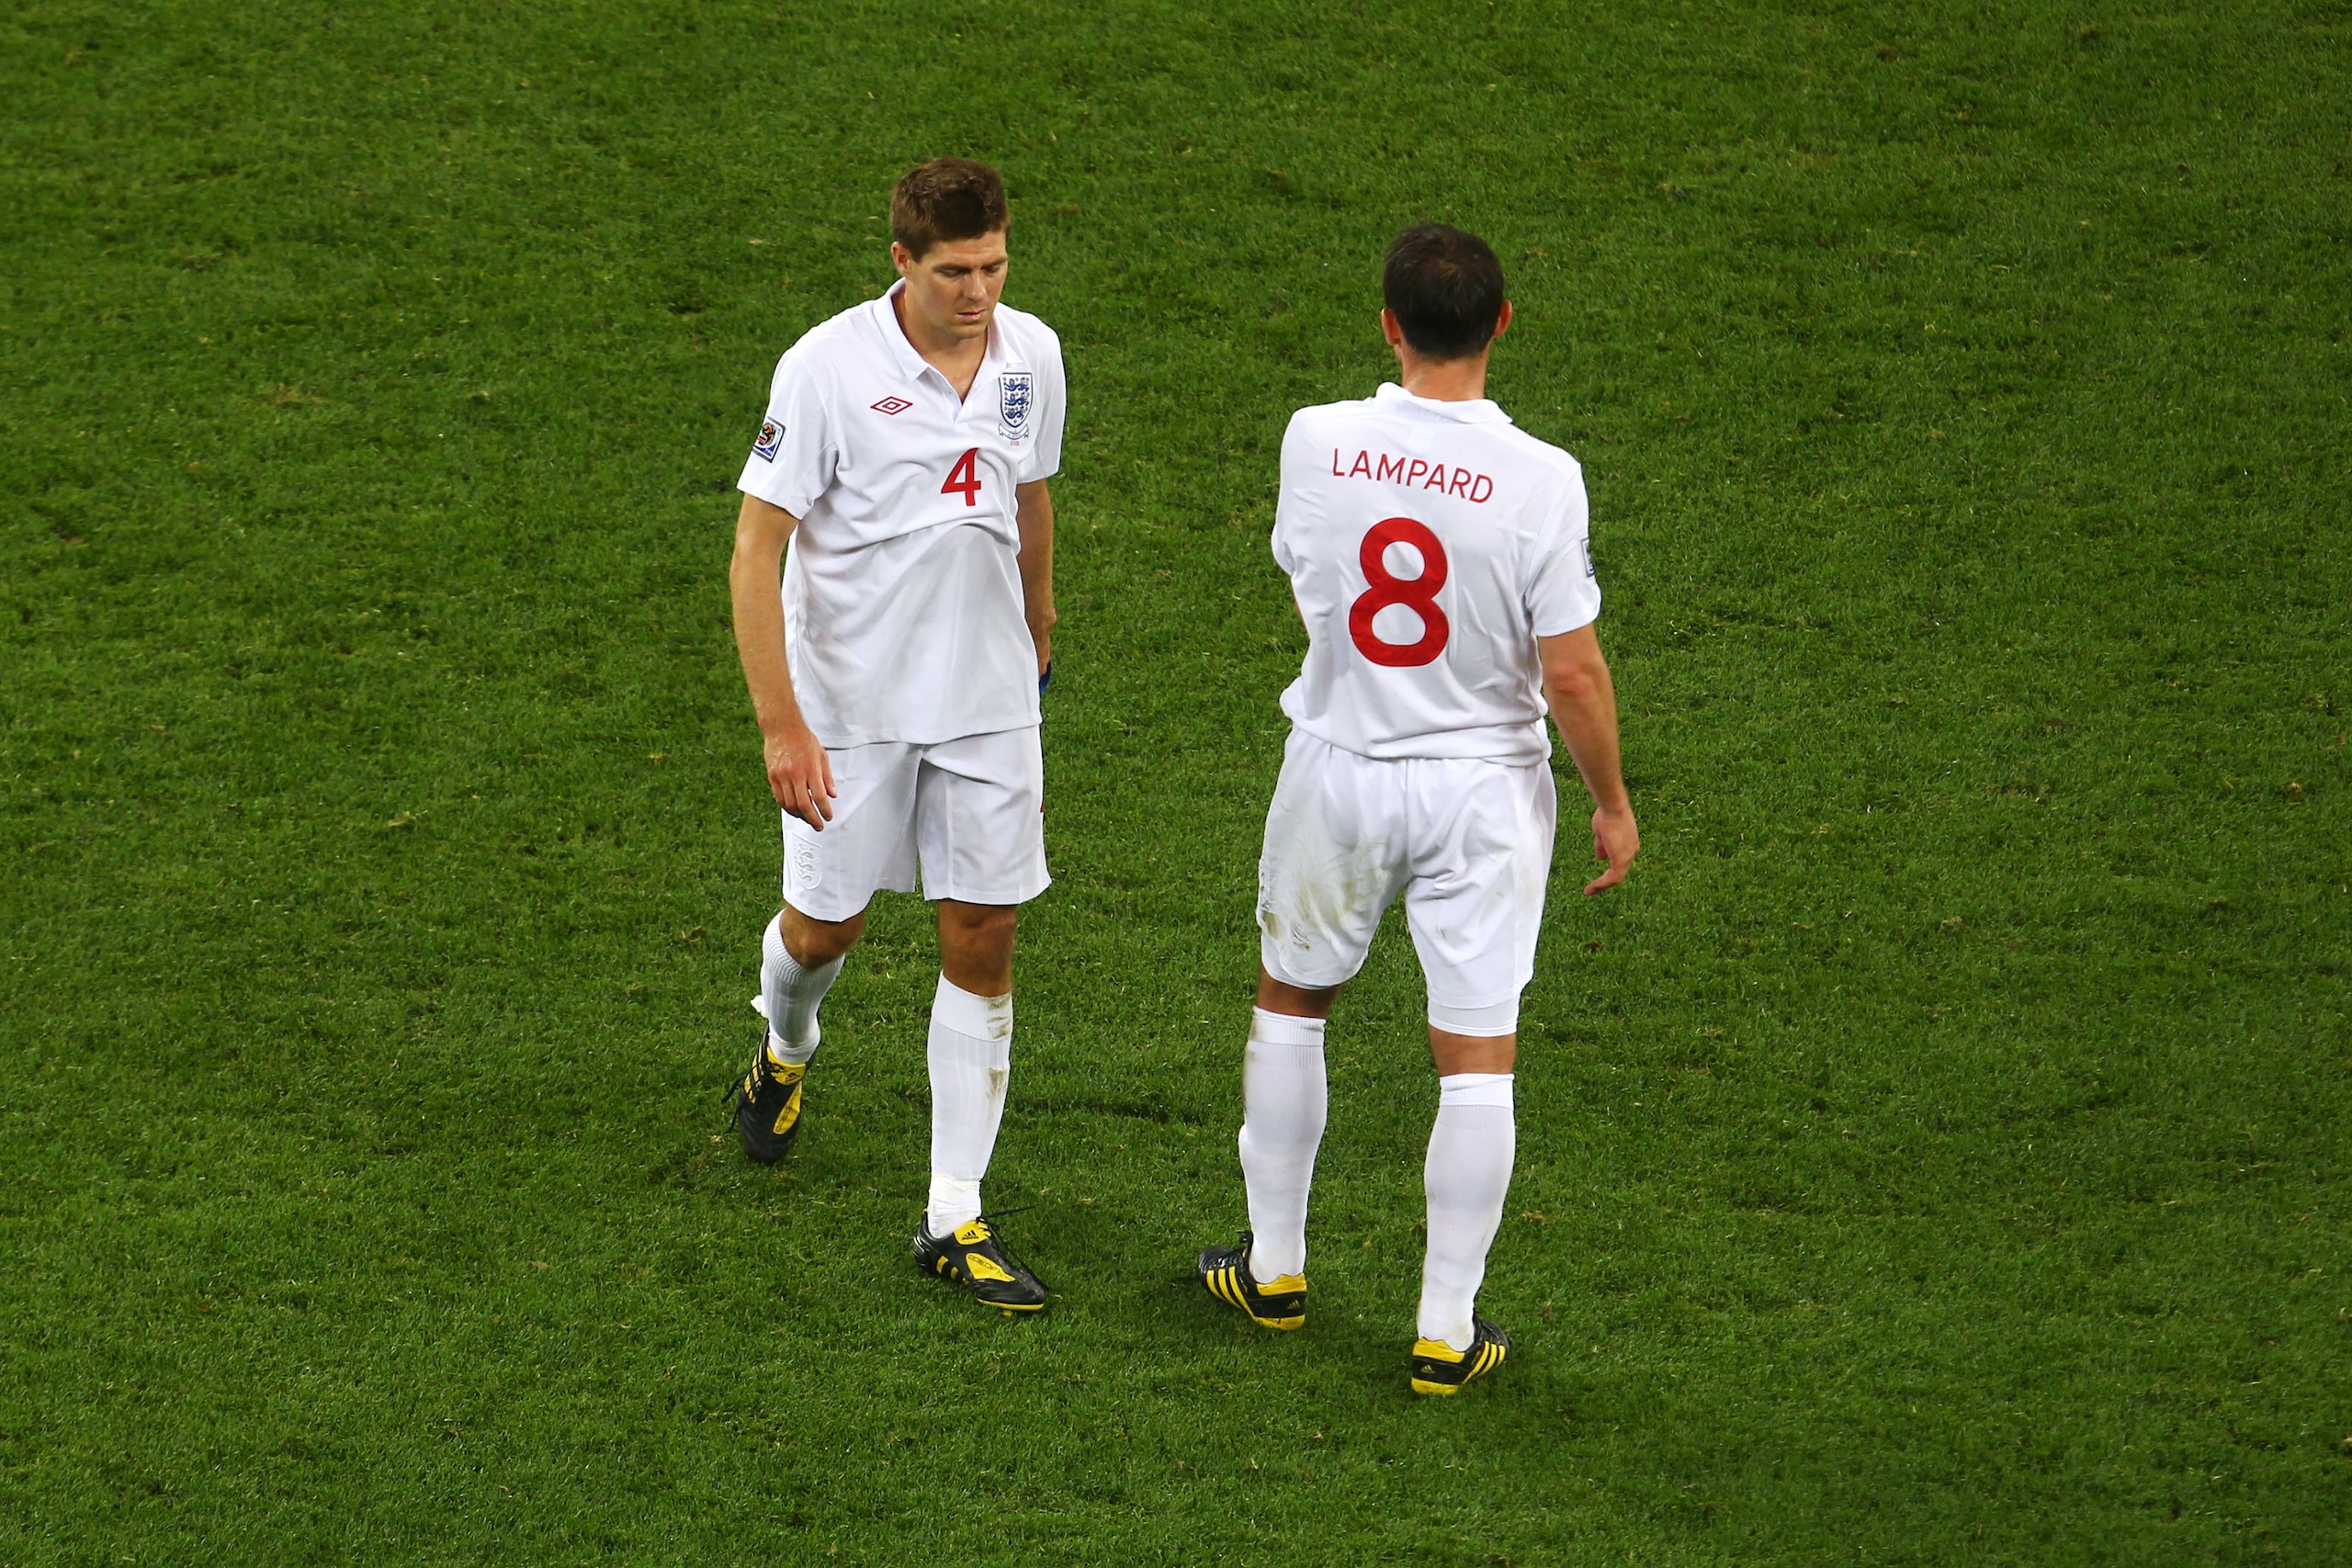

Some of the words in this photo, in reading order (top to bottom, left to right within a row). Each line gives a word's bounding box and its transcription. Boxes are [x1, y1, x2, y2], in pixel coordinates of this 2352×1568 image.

[941, 448, 982, 507] 4
[1333, 448, 1495, 504] LAMPARD
[1349, 516, 1450, 668] 8
